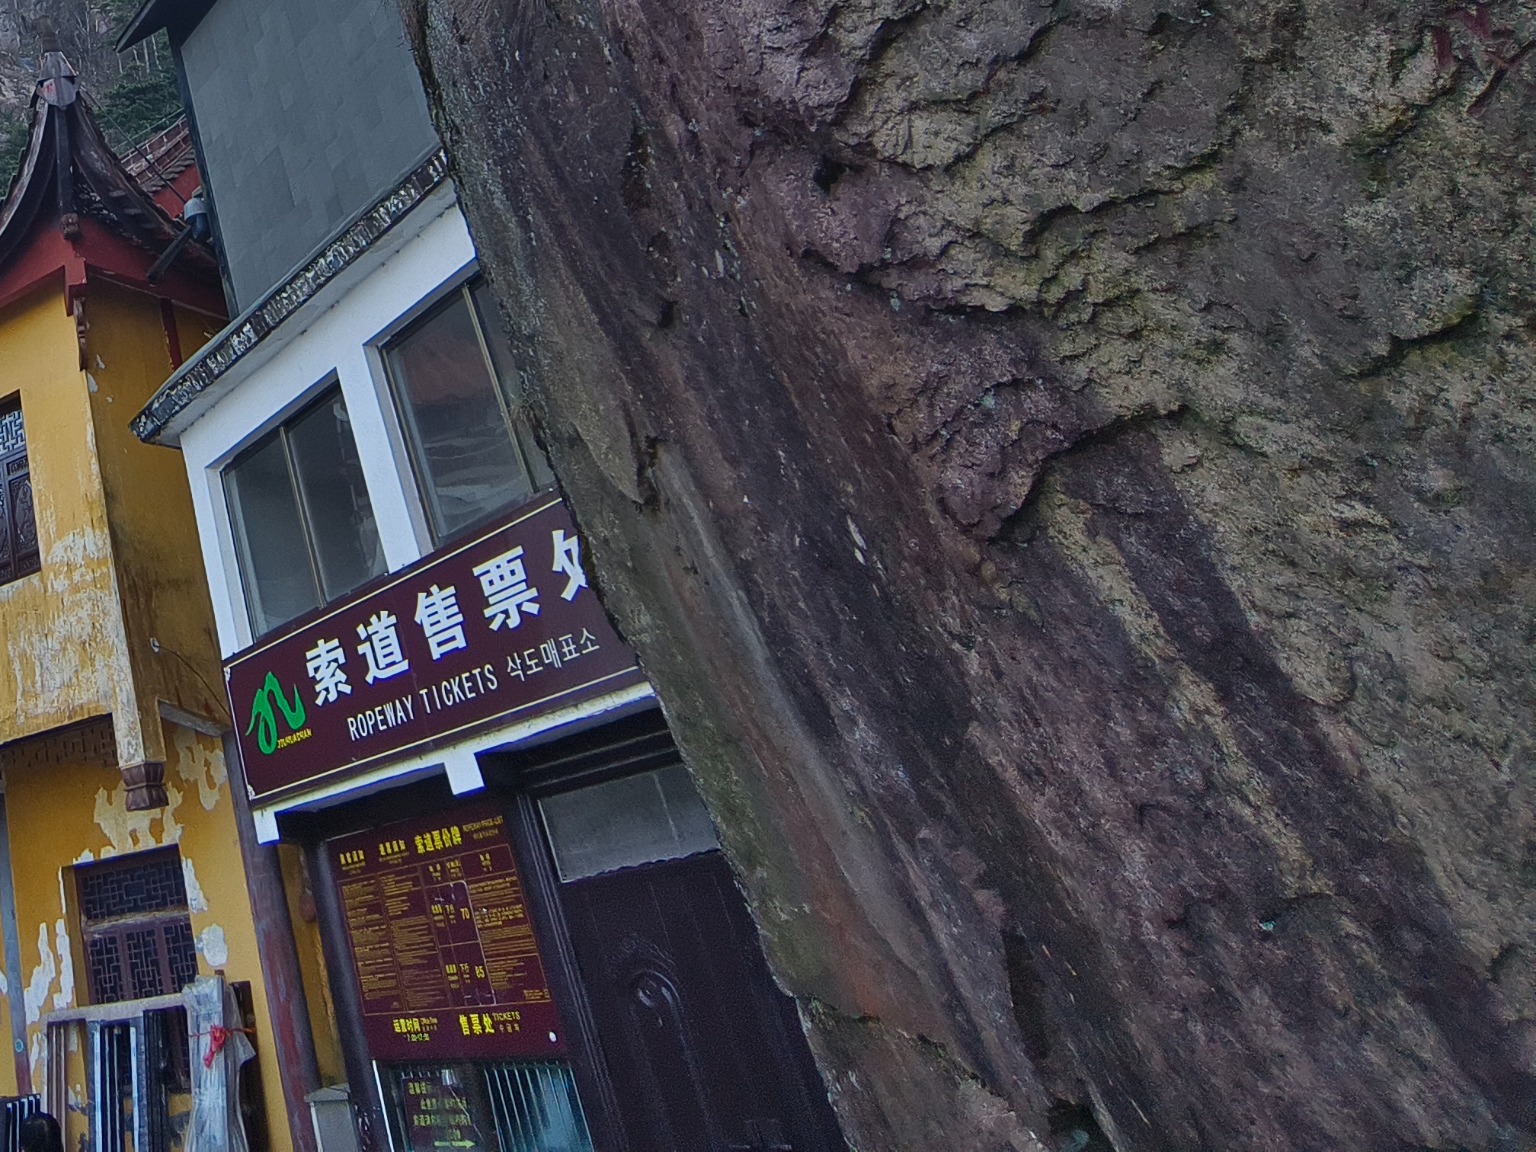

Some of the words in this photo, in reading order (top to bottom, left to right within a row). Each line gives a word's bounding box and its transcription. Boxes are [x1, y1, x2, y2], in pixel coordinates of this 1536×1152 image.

[506, 628, 600, 683] 삭도매표소
[346, 695, 415, 741] ROPEWAY
[419, 664, 498, 714] TICKETS
[459, 1013, 495, 1035] 售票处
[492, 1011, 521, 1021] TICKETS
